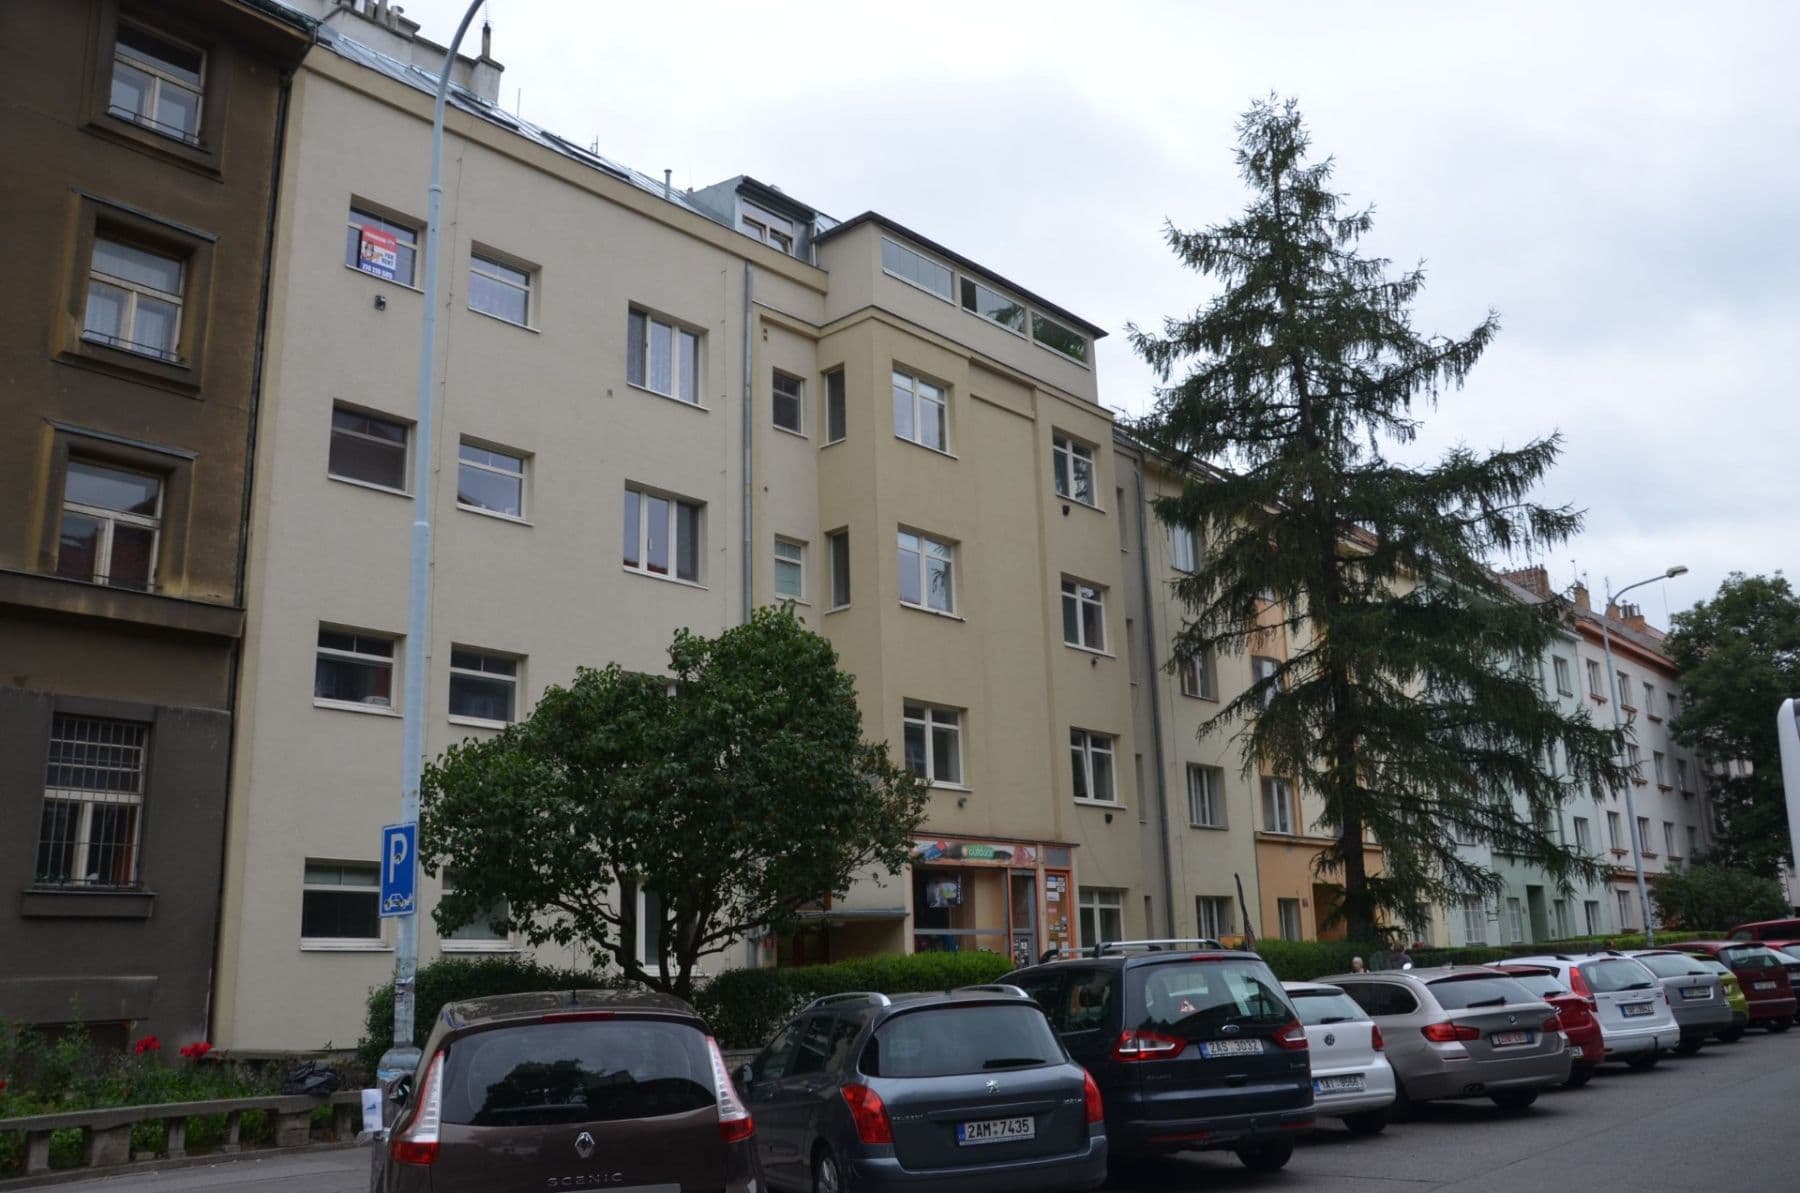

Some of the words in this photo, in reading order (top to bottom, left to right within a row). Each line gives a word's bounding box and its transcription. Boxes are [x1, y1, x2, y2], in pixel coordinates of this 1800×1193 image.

[389, 833, 408, 883] P
[968, 1125, 992, 1139] 2AM
[1000, 1119, 1029, 1136] 7435
[547, 1172, 623, 1187] SCENIC
